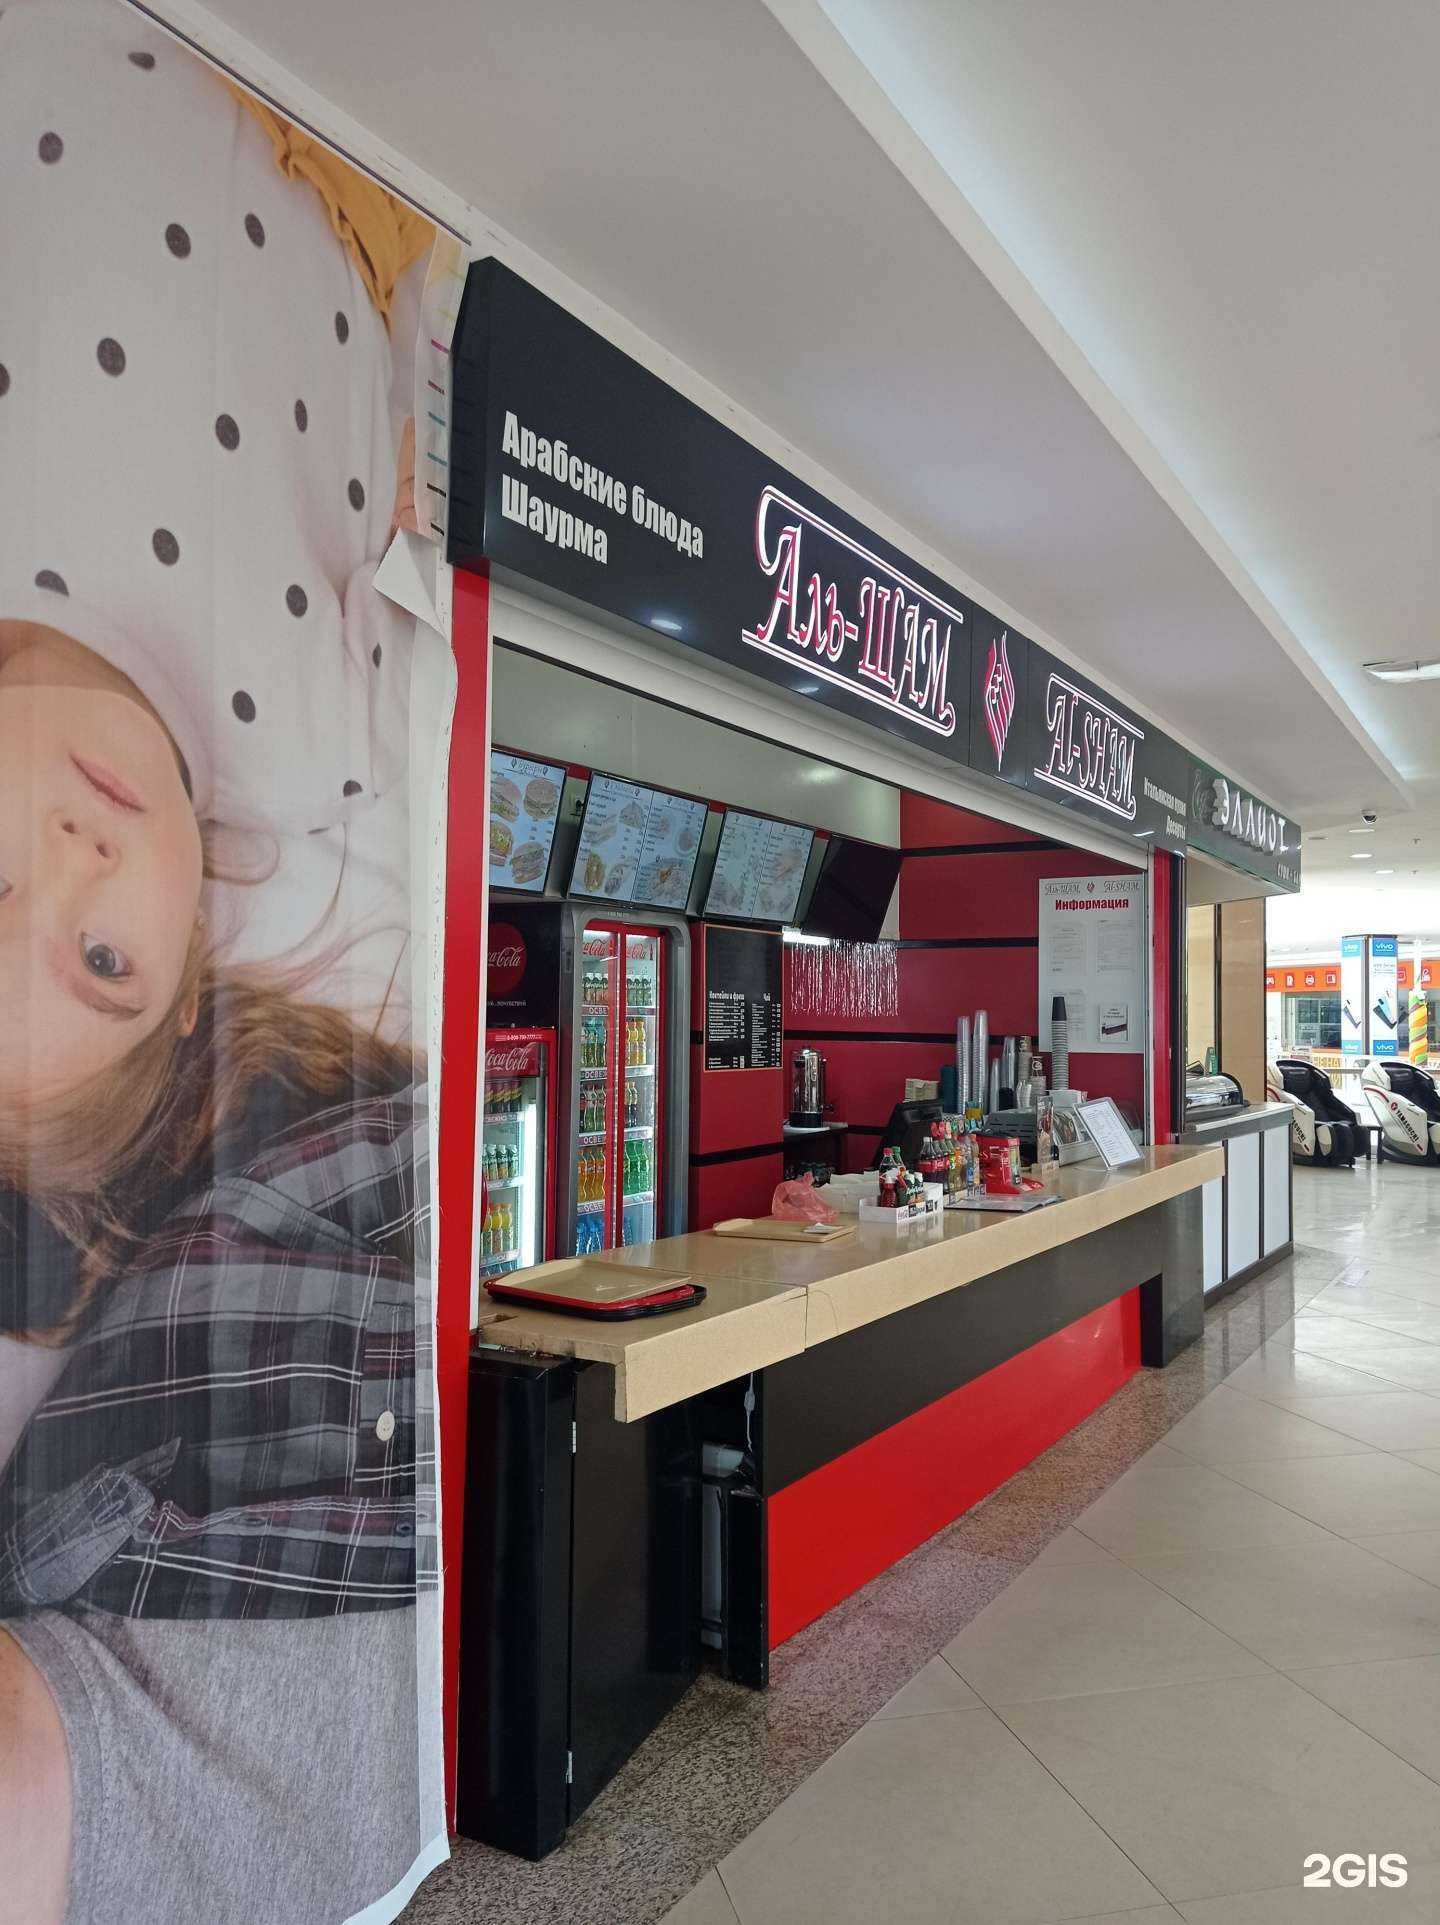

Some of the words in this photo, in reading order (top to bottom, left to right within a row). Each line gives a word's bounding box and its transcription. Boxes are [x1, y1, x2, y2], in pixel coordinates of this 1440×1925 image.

[502, 410, 627, 516] Арабские
[632, 485, 703, 558] блюда
[501, 474, 608, 564] Шаурма
[1055, 899, 1129, 910] Информация
[1376, 942, 1394, 950] vivo
